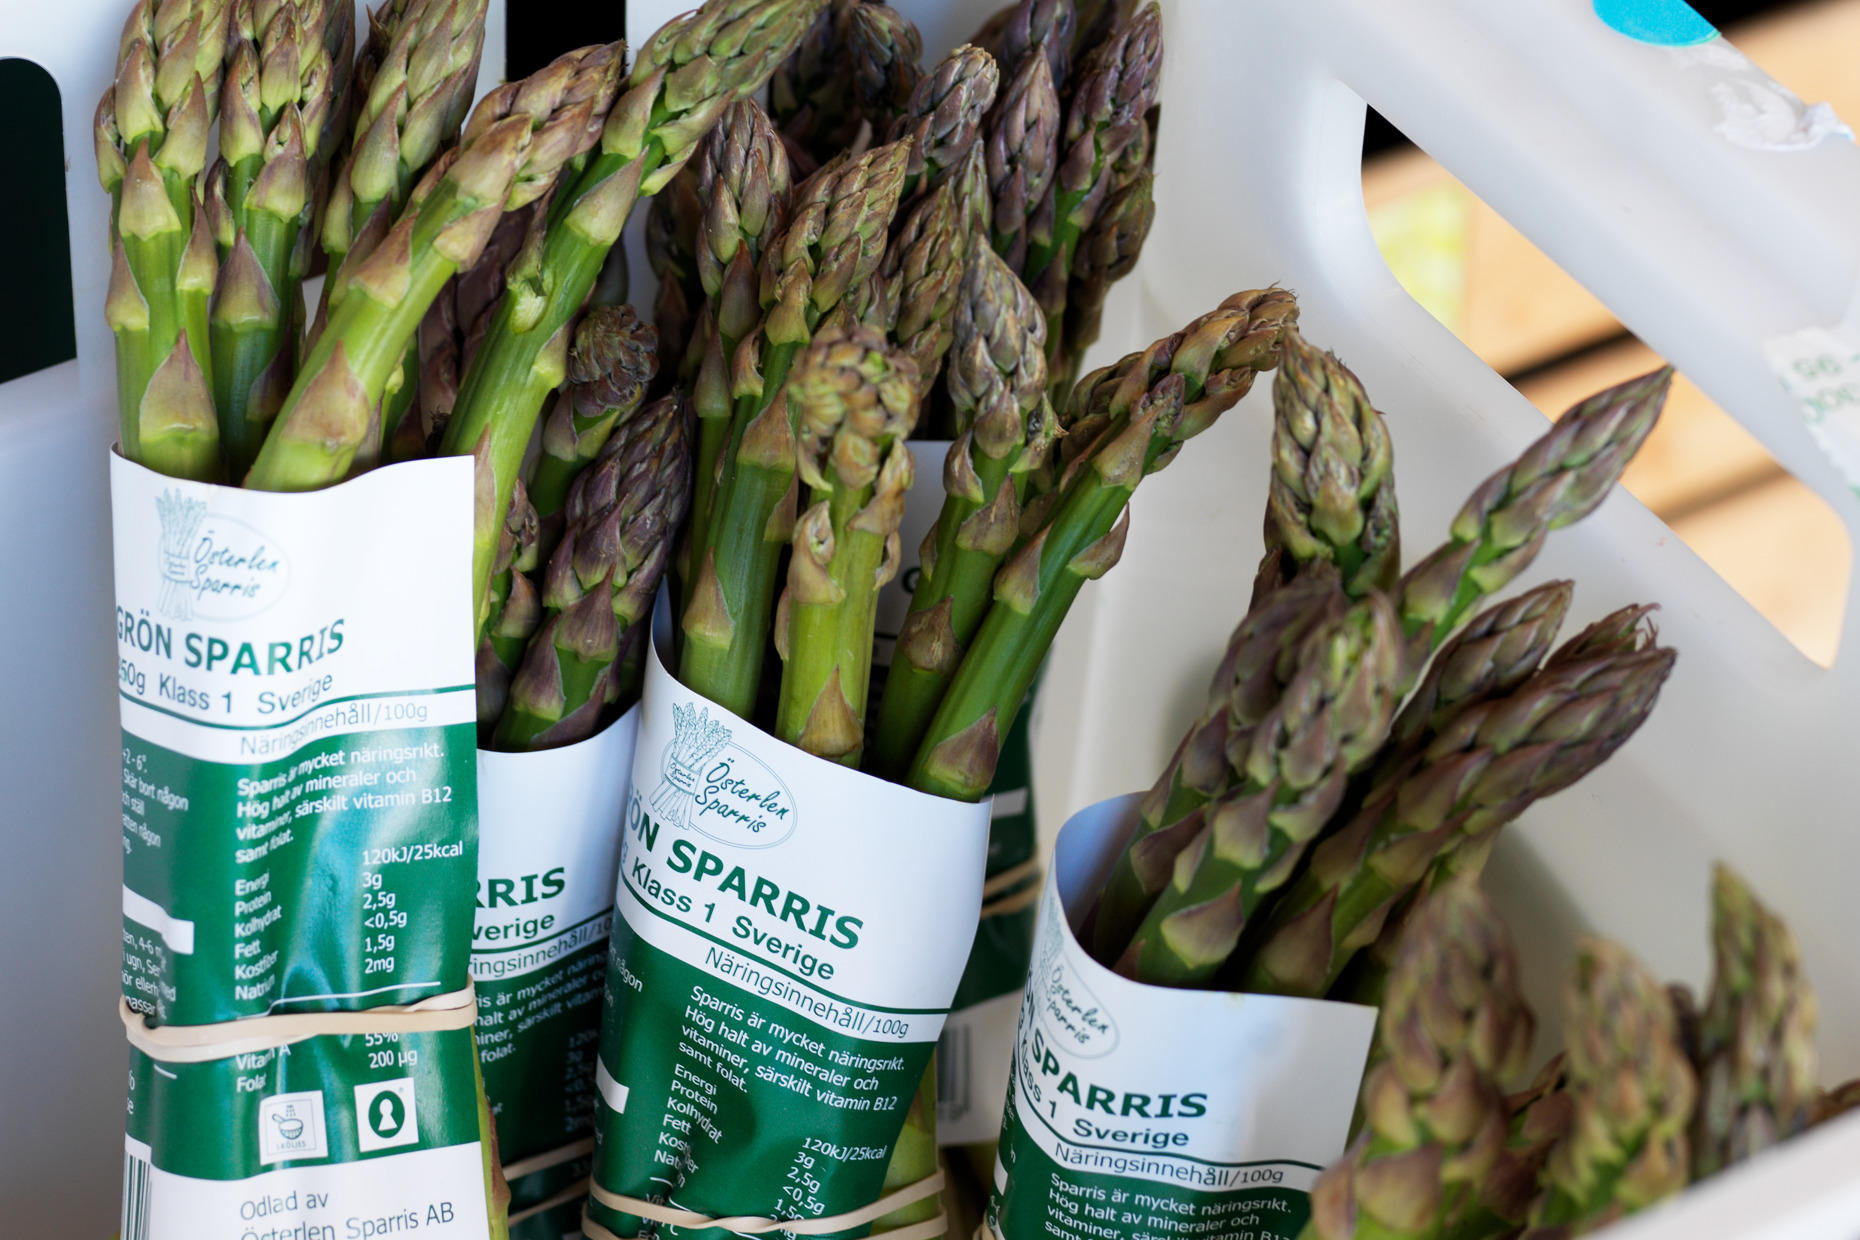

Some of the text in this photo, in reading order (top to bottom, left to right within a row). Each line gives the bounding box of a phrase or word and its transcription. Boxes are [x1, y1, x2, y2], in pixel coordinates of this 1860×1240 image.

[185, 618, 344, 676] SPARRIS
[119, 658, 333, 715] 50g Klass 1 Sverige
[237, 773, 288, 799] Sparris
[297, 750, 346, 775] mycket
[350, 742, 445, 765] näringsrikt.
[237, 800, 270, 820] Hög
[305, 771, 381, 794] mineraler
[386, 767, 417, 784] och
[706, 757, 790, 821] Österlen
[156, 785, 189, 811] någon
[295, 795, 349, 819] särskilt
[352, 791, 416, 811] vitamin
[421, 786, 452, 805] B12
[694, 785, 767, 833] Sparris
[362, 841, 463, 866] 120kJ/25kcal
[362, 872, 382, 893] 3g
[363, 891, 396, 910] 2,5g
[667, 839, 864, 950] SPARRIS
[235, 911, 408, 959] Fett <0,5g
[474, 914, 555, 941] verige
[632, 856, 835, 981] Klass 1 Sverige
[364, 934, 395, 953] 1,5g
[364, 957, 395, 974] 2mg
[508, 1006, 526, 1022] av
[704, 946, 909, 1038] Näringsinnehåll/100g
[685, 1005, 879, 1091] Hög halt av mineraler och
[690, 985, 905, 1074] Sparris är mycket näringsrikt.
[368, 1050, 395, 1069] 200
[678, 1041, 748, 1093] samt folat.
[682, 1024, 898, 1112] vitaminer, särskilt vitamin B12
[1031, 1027, 1207, 1119] SPARRIS
[671, 1080, 815, 1170] Protein 3g
[674, 1063, 888, 1163] Energi 120kJ/25kcal
[1049, 1100, 1056, 1118] 1
[1072, 1118, 1189, 1149] Sverige
[662, 1114, 825, 1215] Fett <0,5g
[666, 1097, 821, 1194] Kolhydrat 2,5g
[1055, 1143, 1283, 1187] Näringsinnehåll/100g
[240, 1190, 328, 1221] Odlad av
[1049, 1189, 1259, 1233] Hög halt av mineraler och
[1051, 1172, 1291, 1215] Sparris är mycket näringsrikt.
[346, 1209, 418, 1240] Sparris
[426, 1201, 455, 1226] AB
